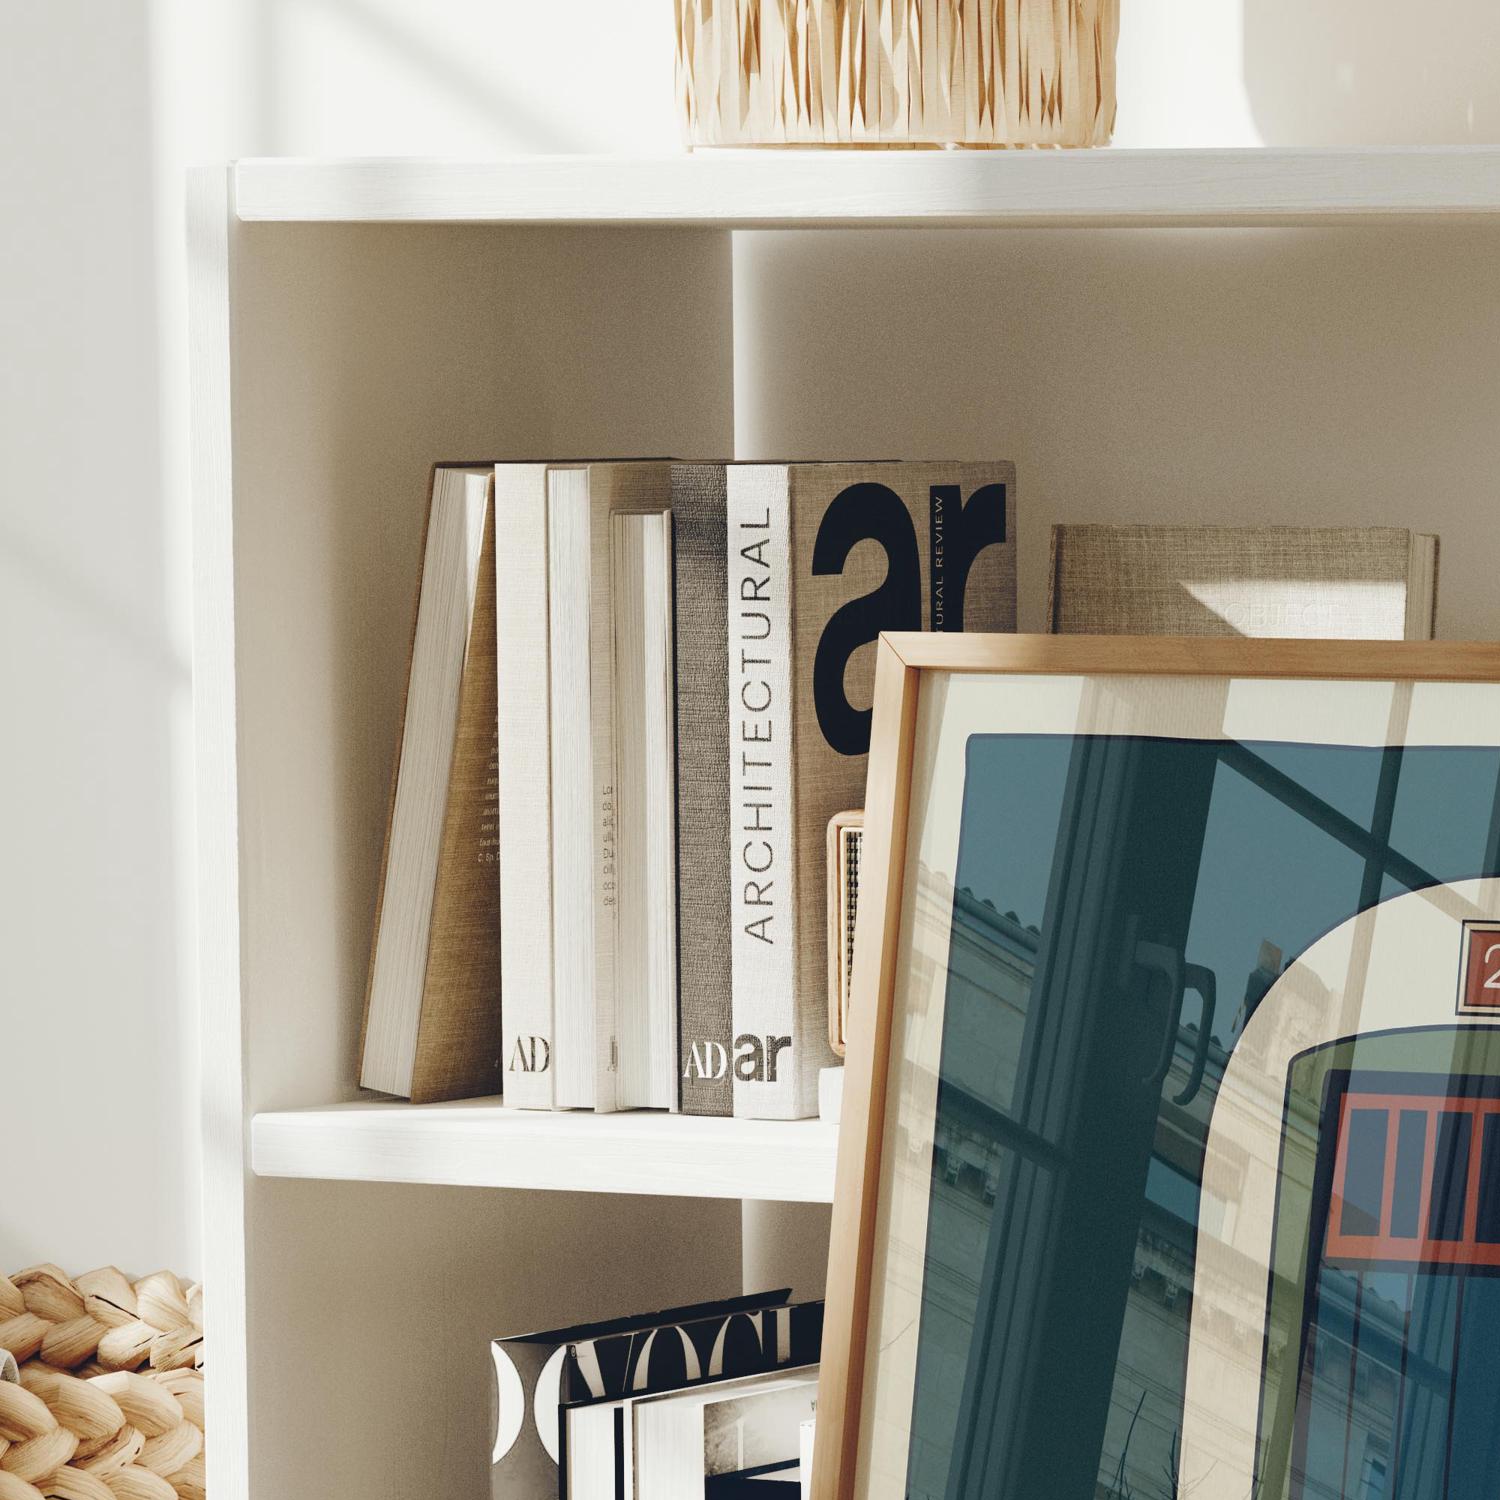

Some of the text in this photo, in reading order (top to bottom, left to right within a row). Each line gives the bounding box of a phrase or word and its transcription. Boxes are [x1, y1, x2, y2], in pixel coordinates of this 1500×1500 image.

[934, 496, 944, 632] URAL REVIEW
[739, 507, 774, 945] ARCHITECTURAL
[508, 1034, 551, 1073] AD
[682, 1040, 728, 1080] AD
[733, 1033, 793, 1083] ar
